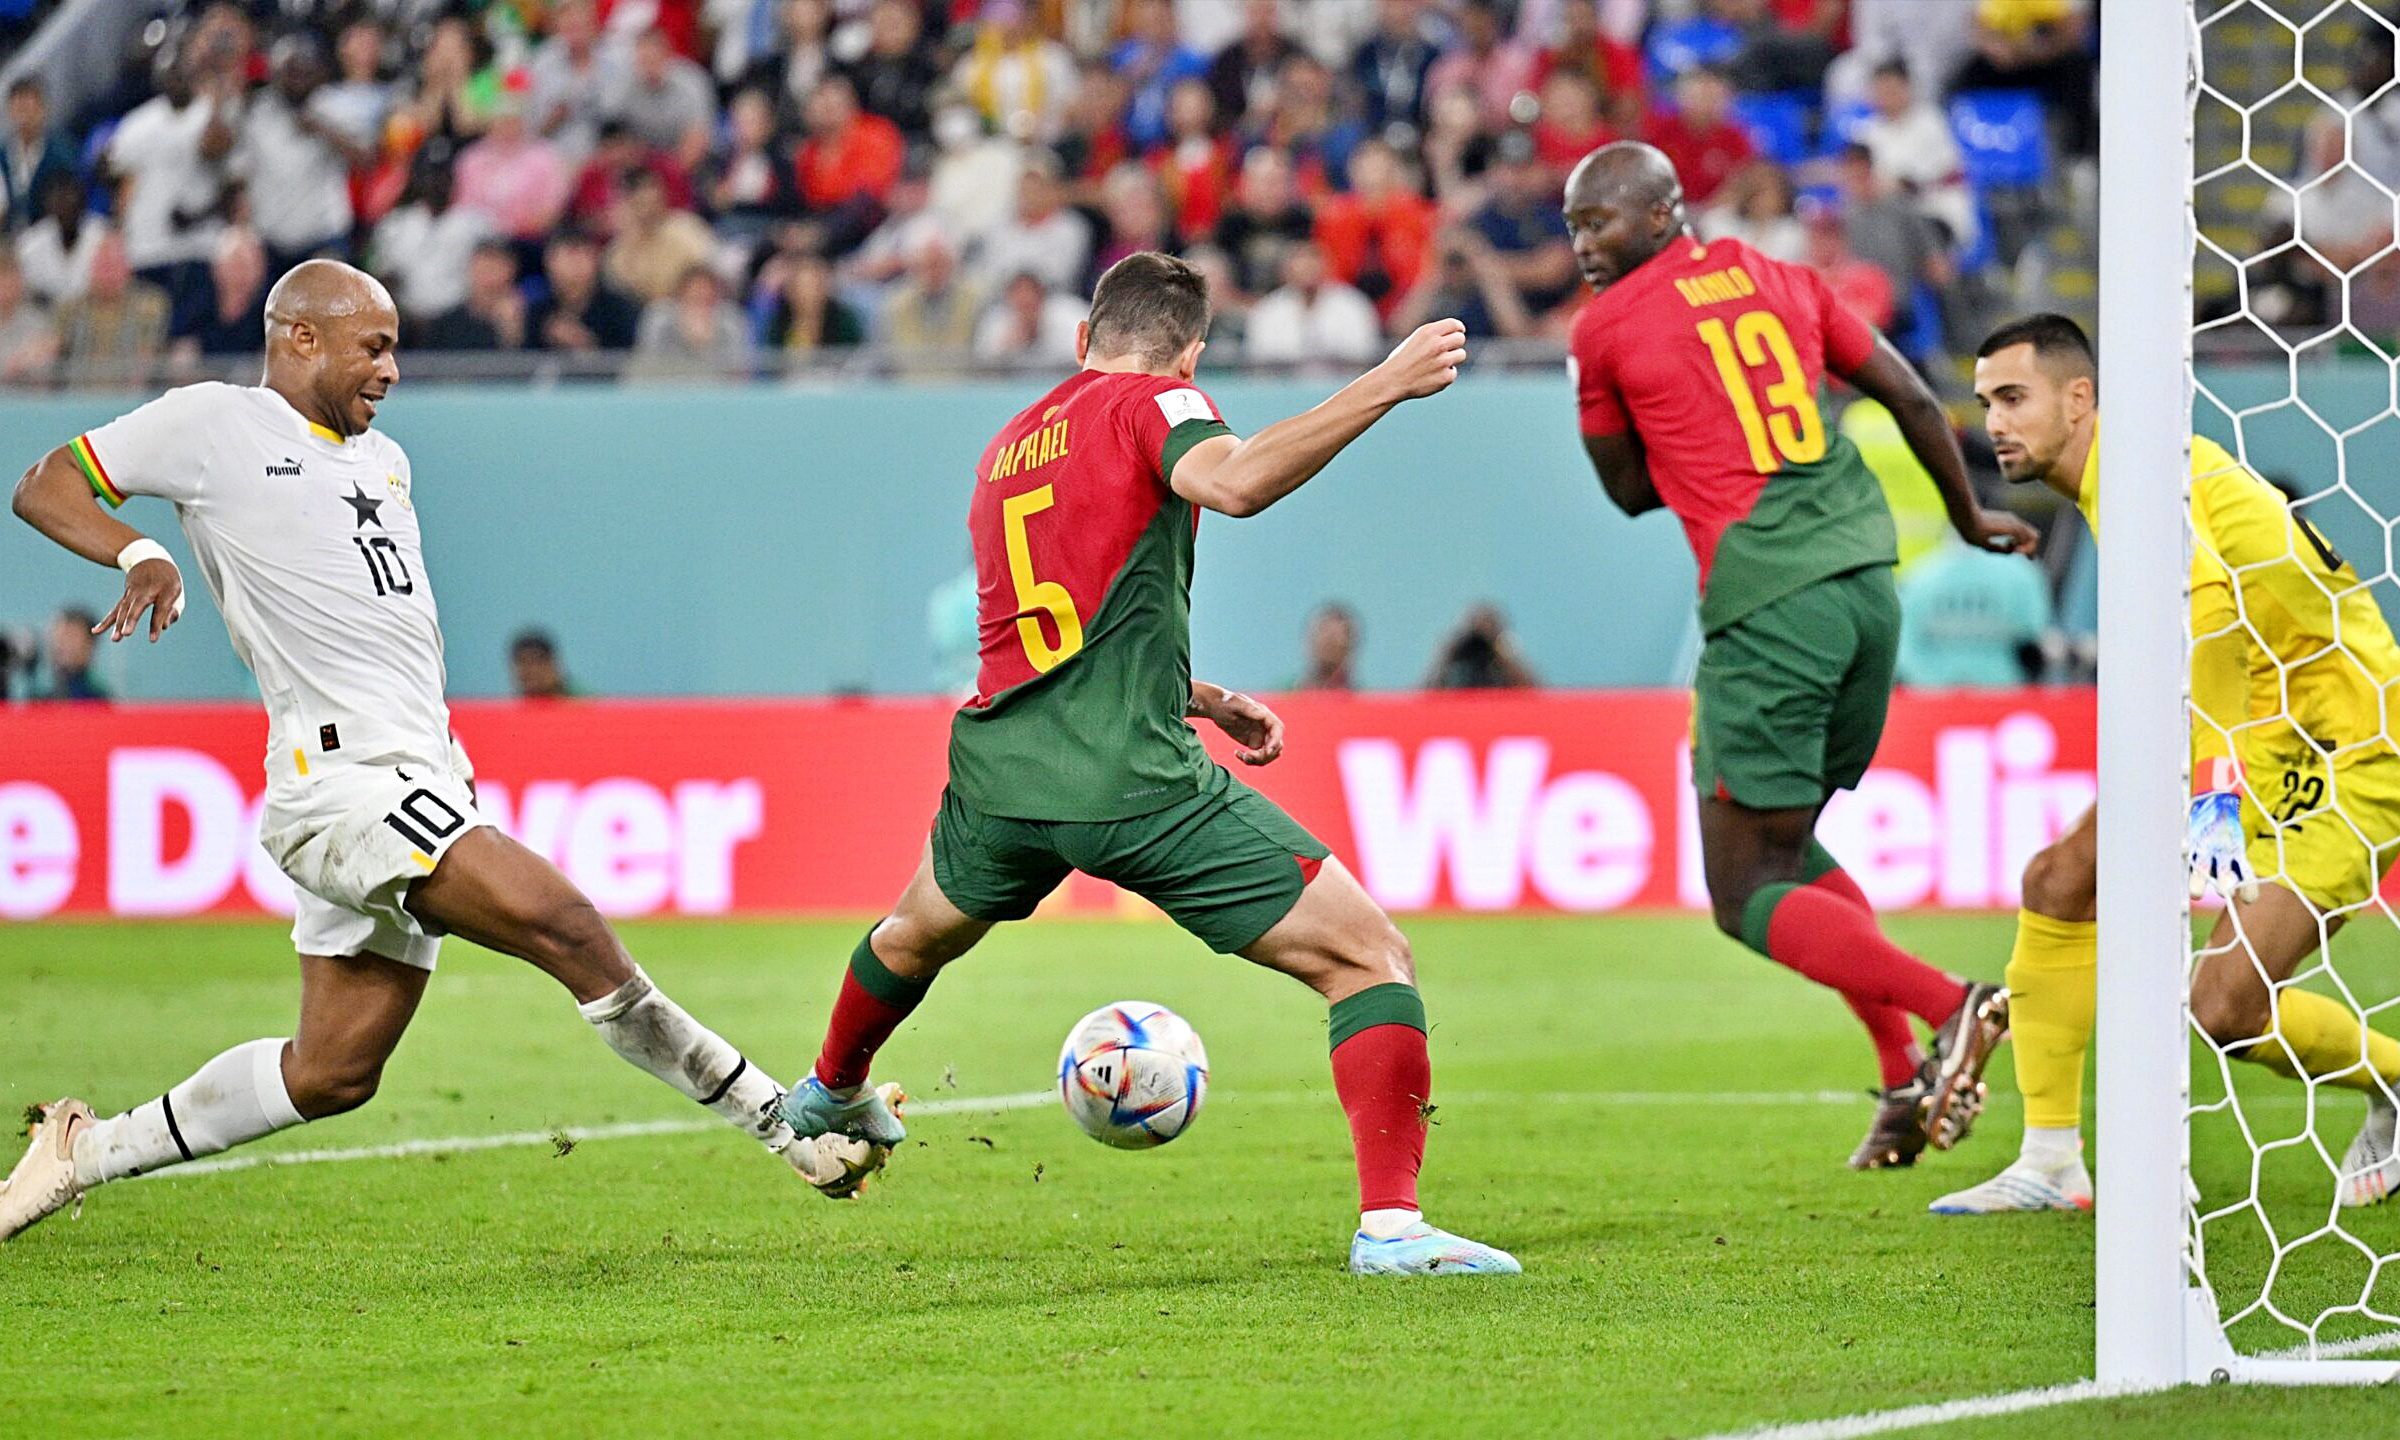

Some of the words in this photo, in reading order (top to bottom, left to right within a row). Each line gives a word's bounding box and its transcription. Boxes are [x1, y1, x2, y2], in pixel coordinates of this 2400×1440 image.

[1673, 265, 1756, 308] DANILO
[1696, 310, 1827, 474] 13
[988, 419, 1069, 483] RAPHAEL
[353, 536, 413, 596] 10
[1003, 483, 1084, 674] 5
[382, 787, 466, 857] 10
[1337, 735, 1655, 912] We
